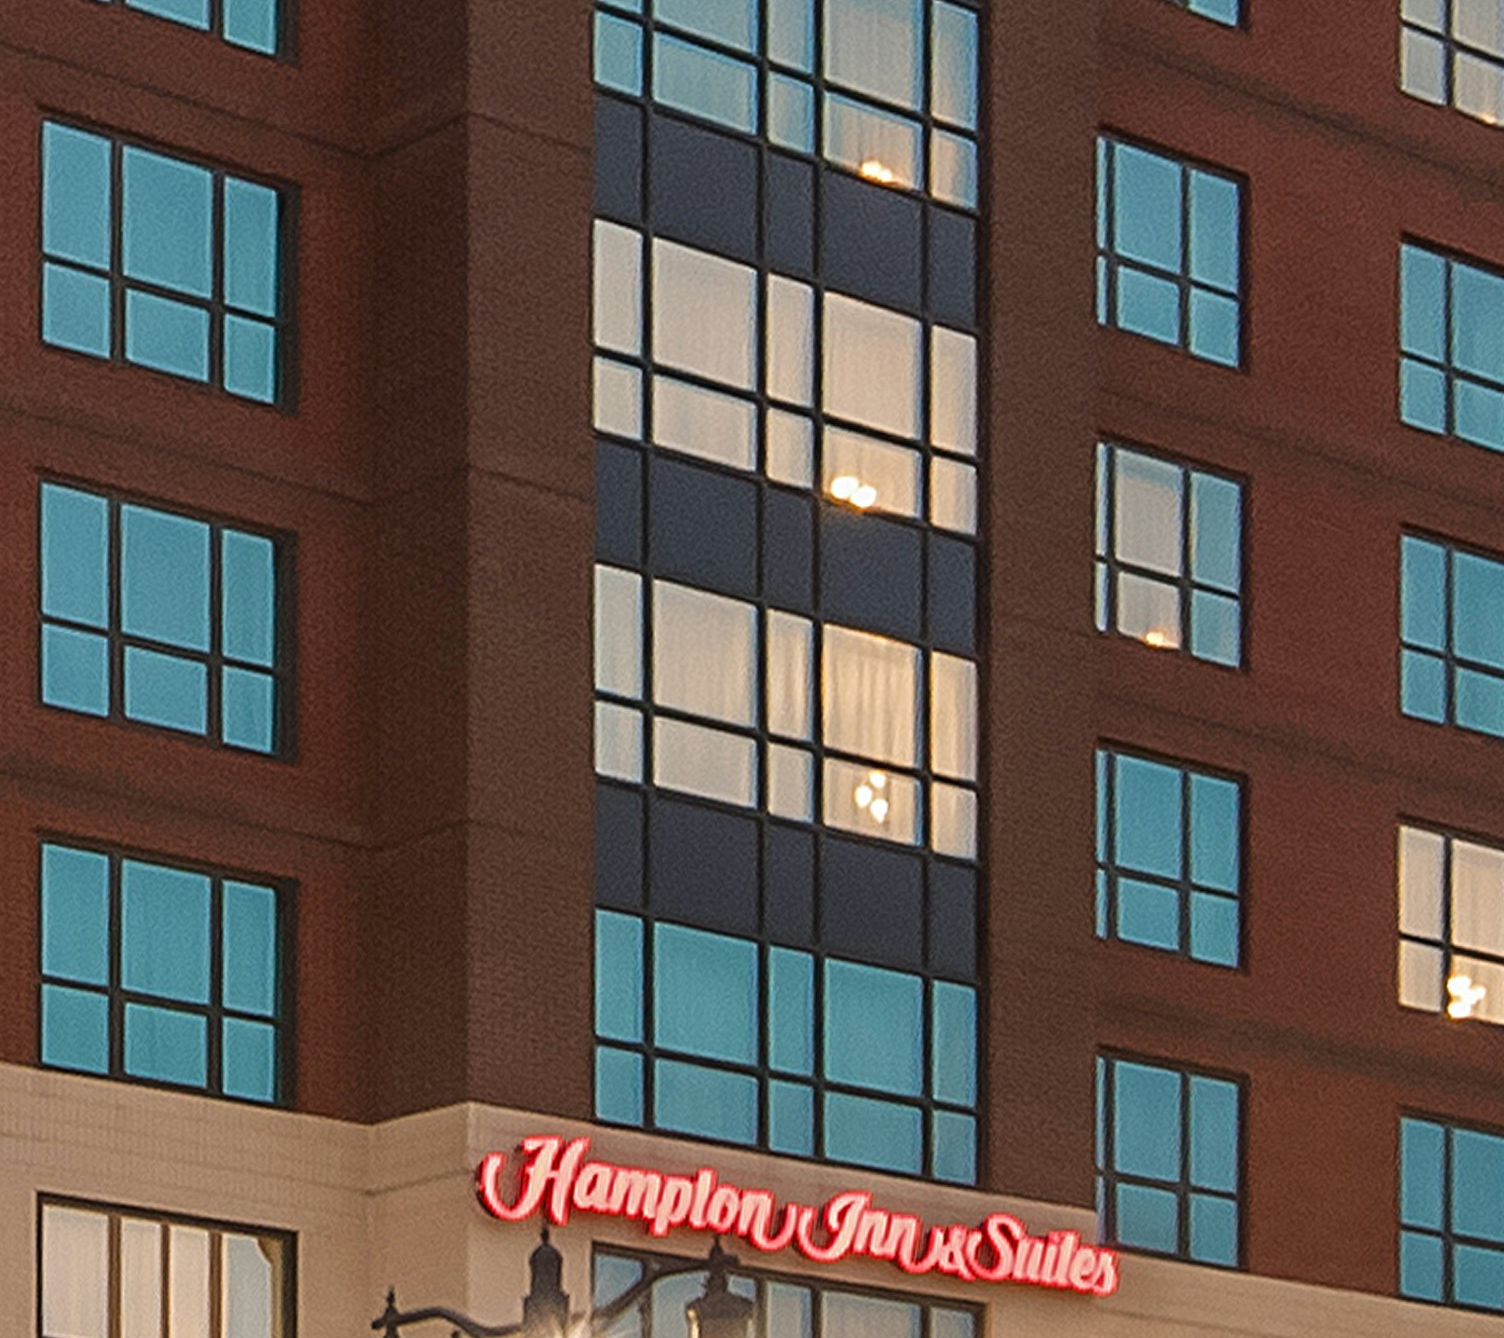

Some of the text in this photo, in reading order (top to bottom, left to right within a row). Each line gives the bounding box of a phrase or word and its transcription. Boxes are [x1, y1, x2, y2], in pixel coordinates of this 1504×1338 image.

[477, 1135, 799, 1253] Hampton
[796, 1191, 940, 1275] Inn
[965, 1211, 1119, 1297] Suites
